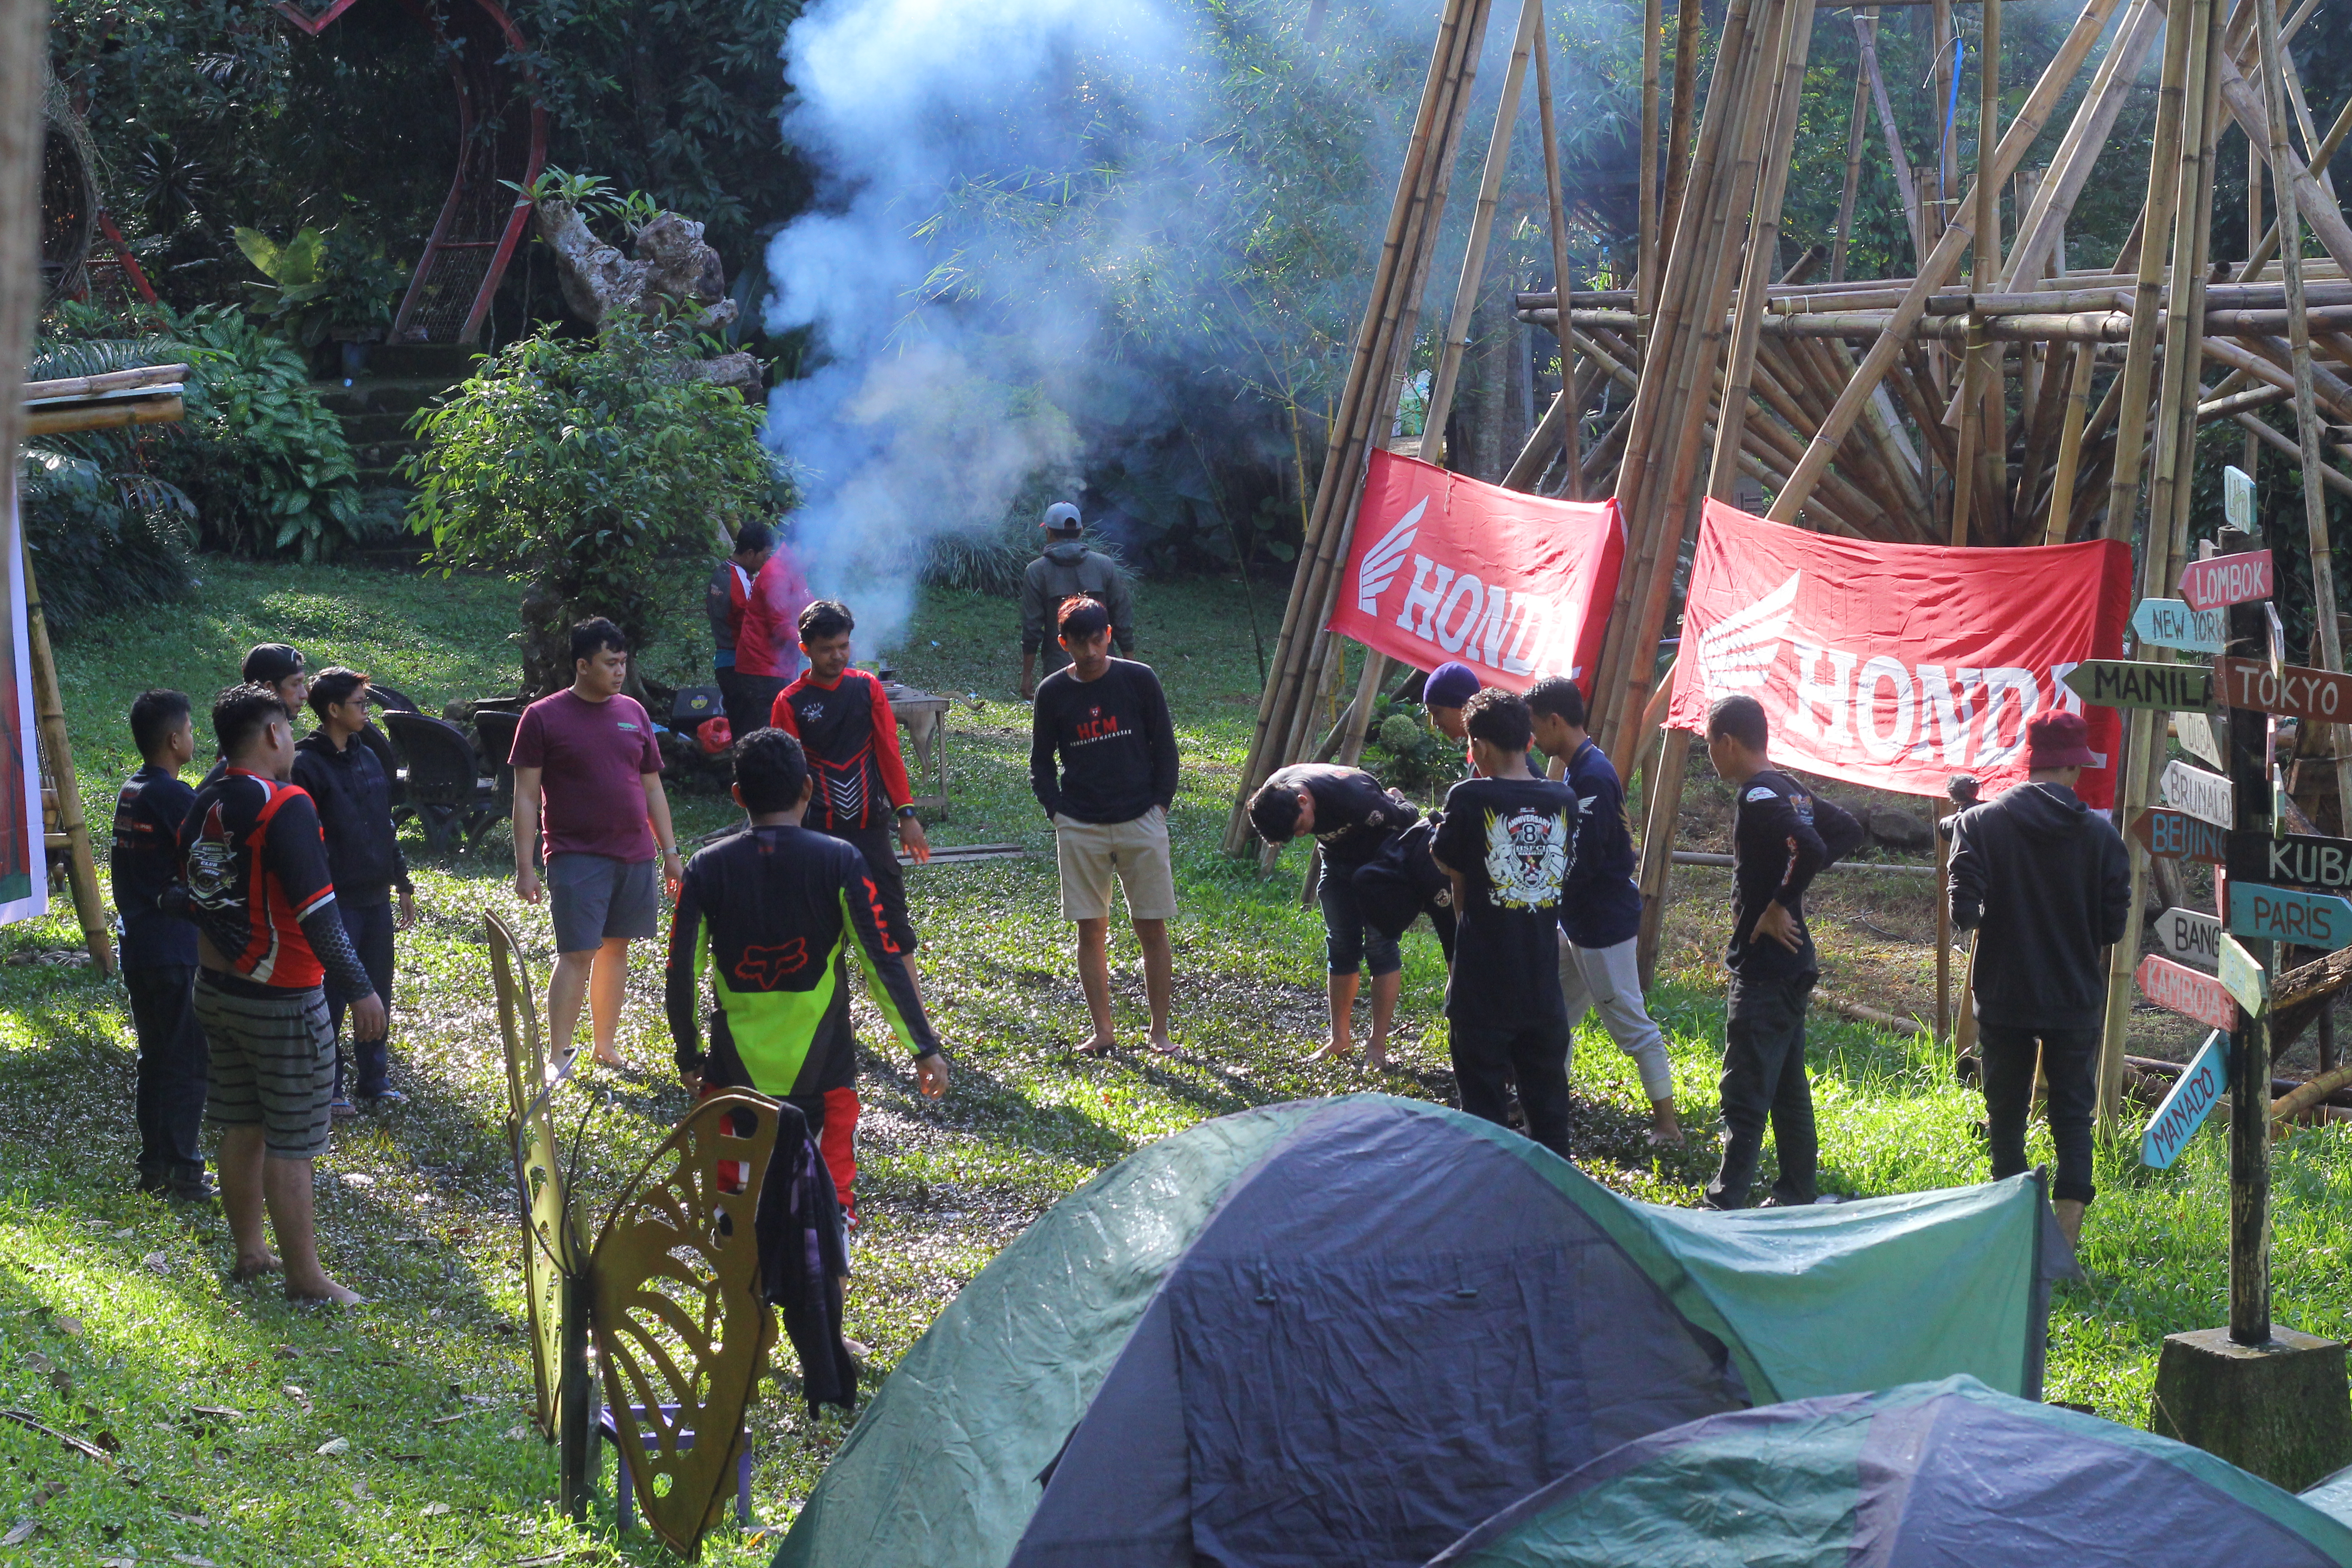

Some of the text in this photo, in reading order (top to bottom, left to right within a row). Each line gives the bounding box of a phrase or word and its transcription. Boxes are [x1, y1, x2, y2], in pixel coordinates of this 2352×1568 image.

[2195, 561, 2265, 606] LOMBOK
[1396, 554, 1582, 682] HONDA
[2153, 608, 2225, 645] NEW YORK
[2235, 665, 2338, 715] TOKYO
[1077, 715, 1117, 740] HCM
[1099, 729, 1132, 740] MAKASSAR
[2188, 713, 2214, 760] DUBAI
[1508, 814, 1551, 829] ANNIVERSARY
[2254, 896, 2332, 940] PARIS
[2147, 960, 2223, 1026] KAMBOJA
[2152, 1066, 2214, 1164] MANADO
